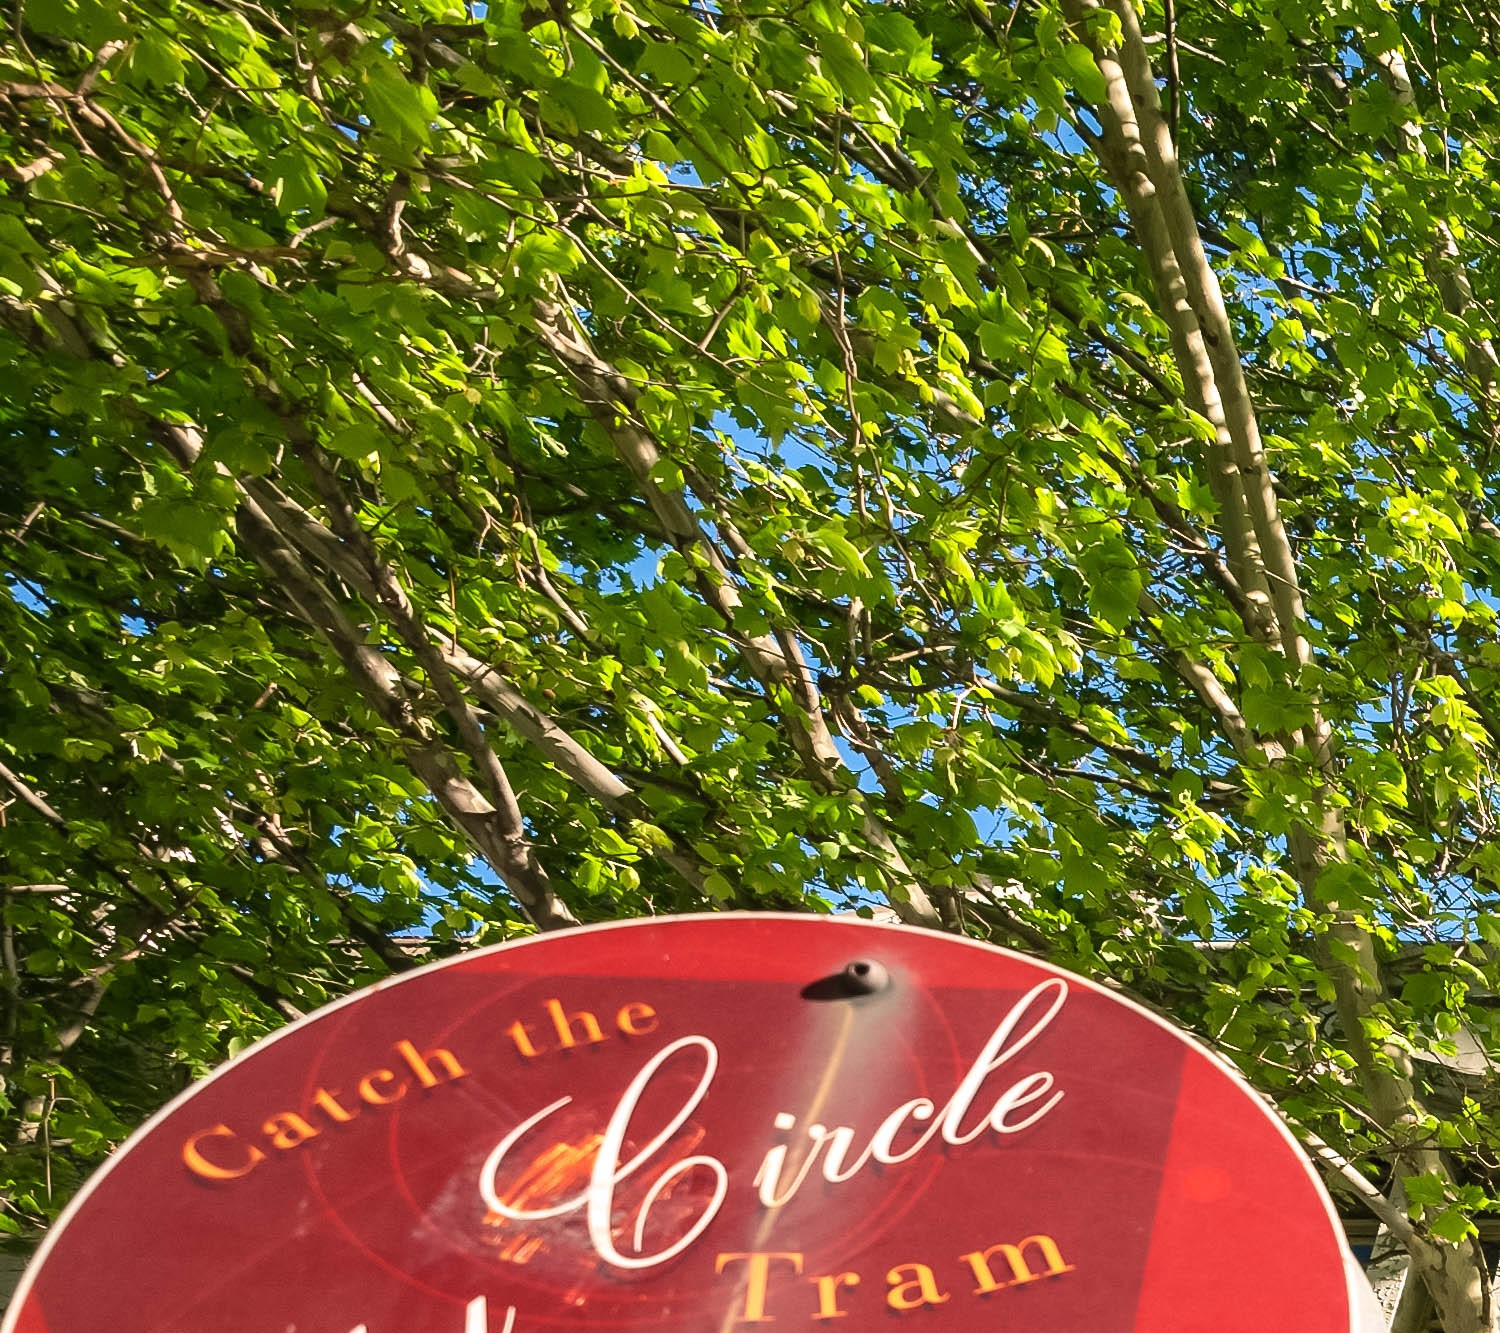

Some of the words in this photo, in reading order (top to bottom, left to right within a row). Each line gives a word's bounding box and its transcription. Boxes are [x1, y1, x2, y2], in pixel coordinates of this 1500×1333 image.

[181, 1031, 467, 1186] Catch
[501, 996, 661, 1067] the
[478, 976, 1069, 1270] Circle
[713, 1228, 1075, 1327] Tram
